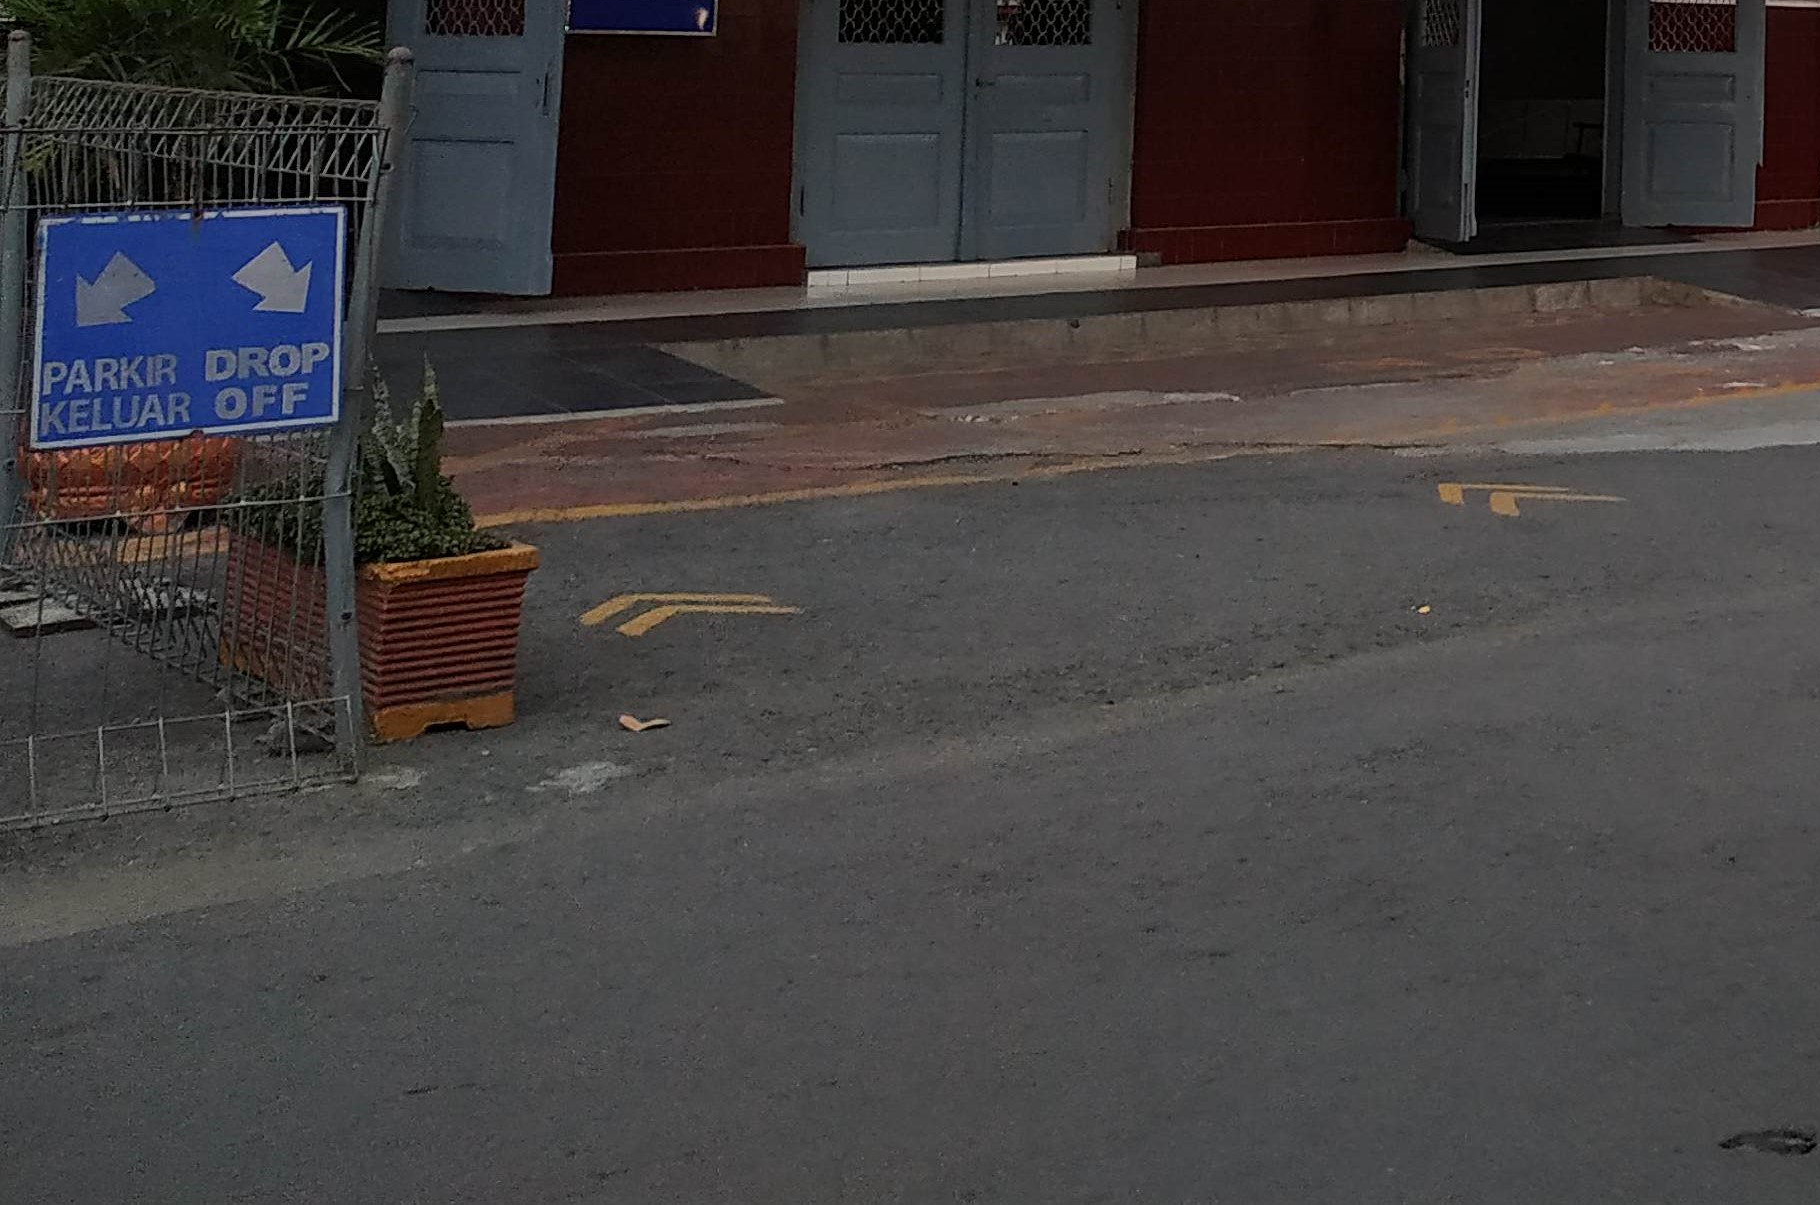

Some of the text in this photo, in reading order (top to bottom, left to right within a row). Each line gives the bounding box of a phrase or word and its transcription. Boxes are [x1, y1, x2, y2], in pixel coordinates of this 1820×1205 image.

[42, 341, 331, 396] PARKIR DROP
[39, 382, 310, 436] KELUAR OFF
